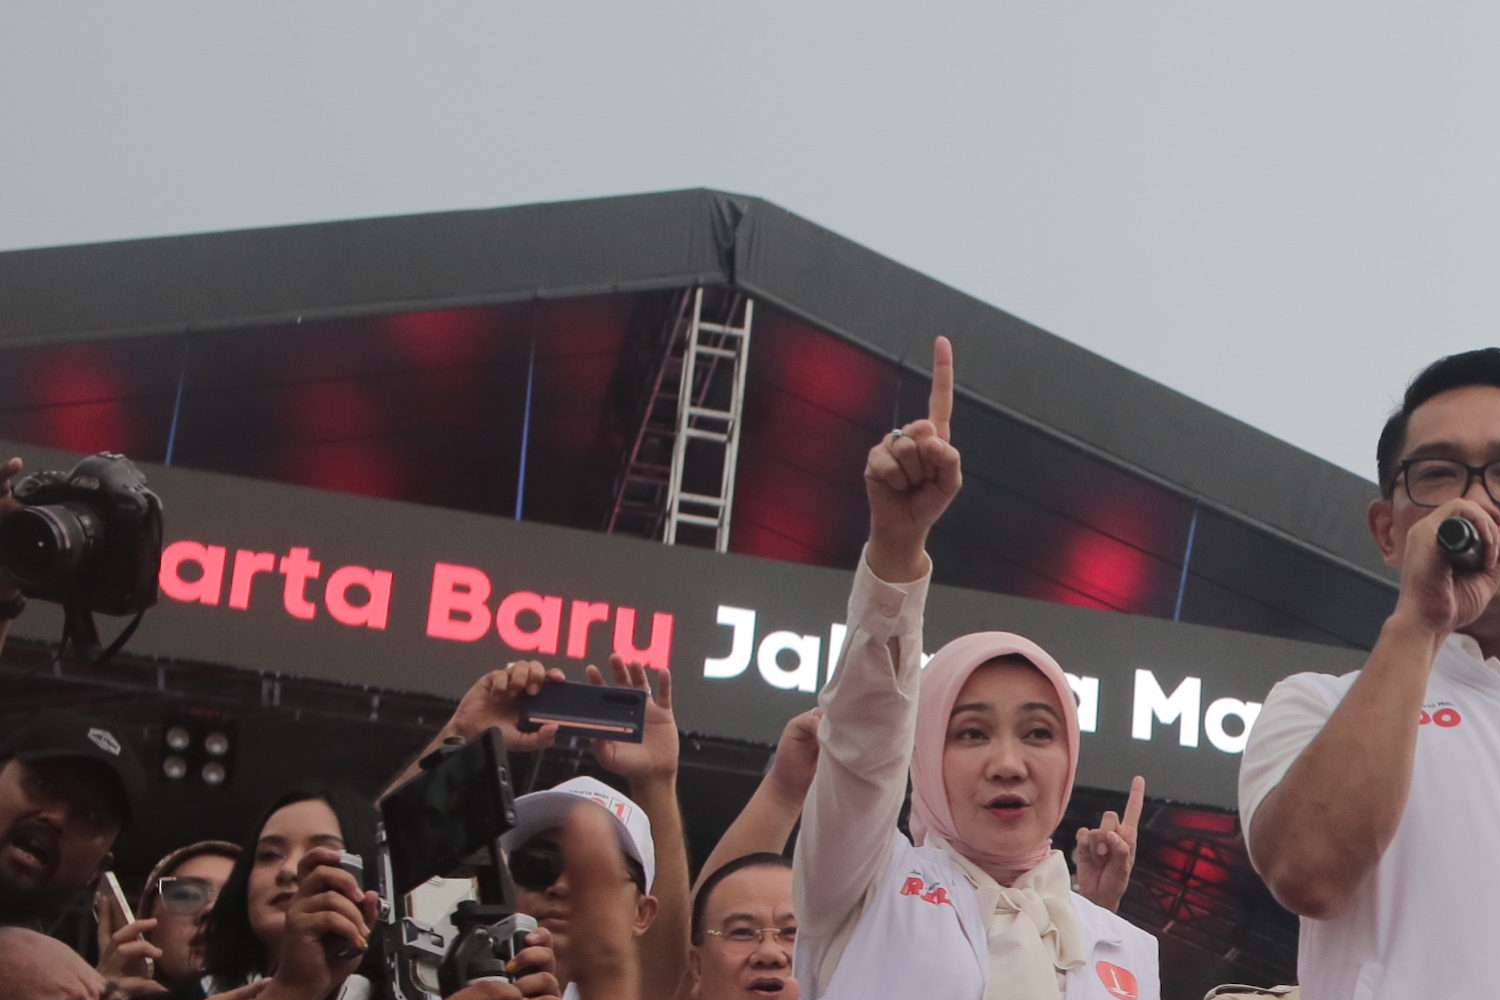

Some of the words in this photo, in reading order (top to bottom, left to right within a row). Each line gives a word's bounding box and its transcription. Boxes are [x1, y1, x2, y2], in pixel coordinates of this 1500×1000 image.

[158, 539, 394, 631] arta
[426, 562, 674, 670] Baru
[1131, 668, 1264, 754] Ma
